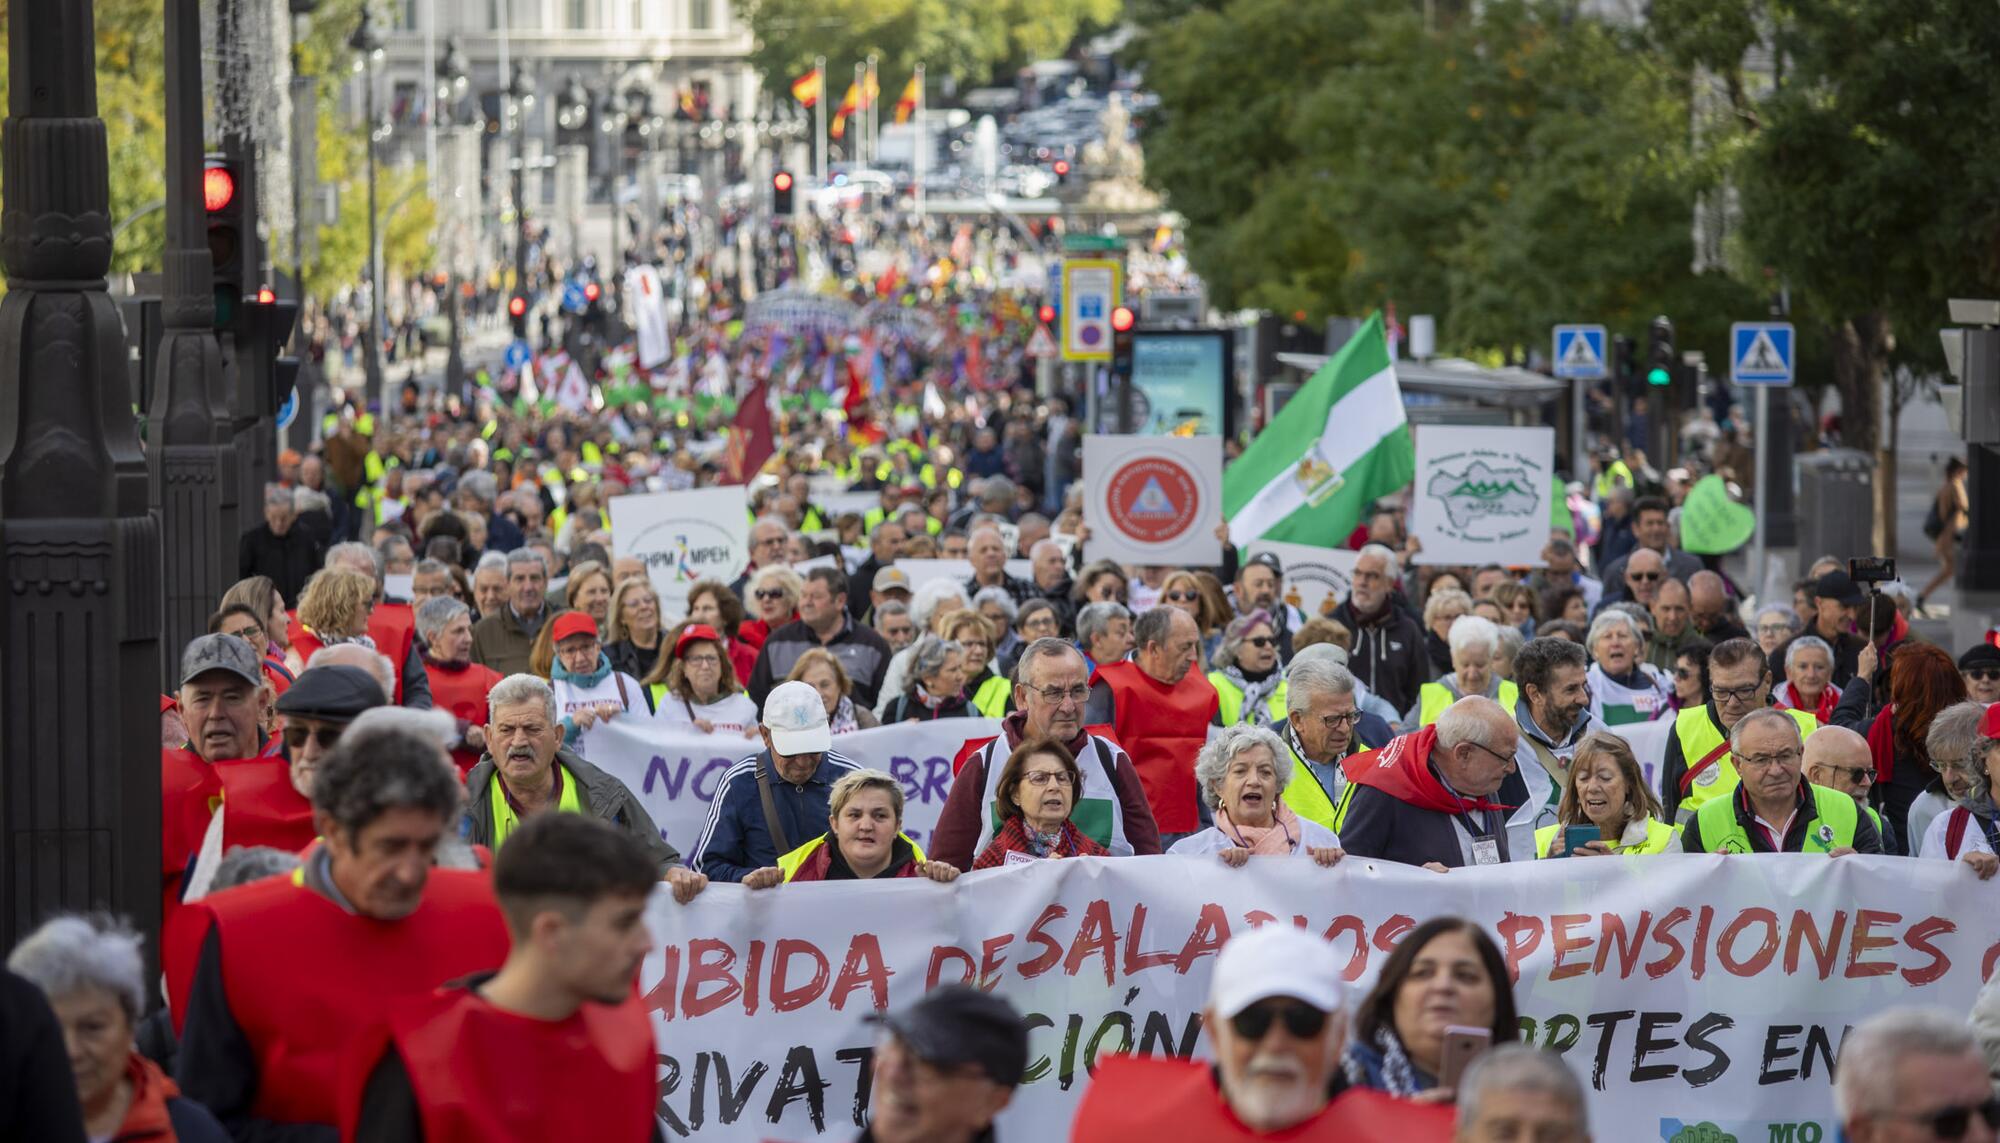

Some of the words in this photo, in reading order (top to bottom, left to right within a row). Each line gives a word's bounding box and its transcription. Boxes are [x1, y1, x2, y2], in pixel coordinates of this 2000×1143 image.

[640, 933, 896, 1022] UBIDA
[1497, 905, 1958, 988] PENSIONES
[1759, 1023, 1855, 1086] EN
